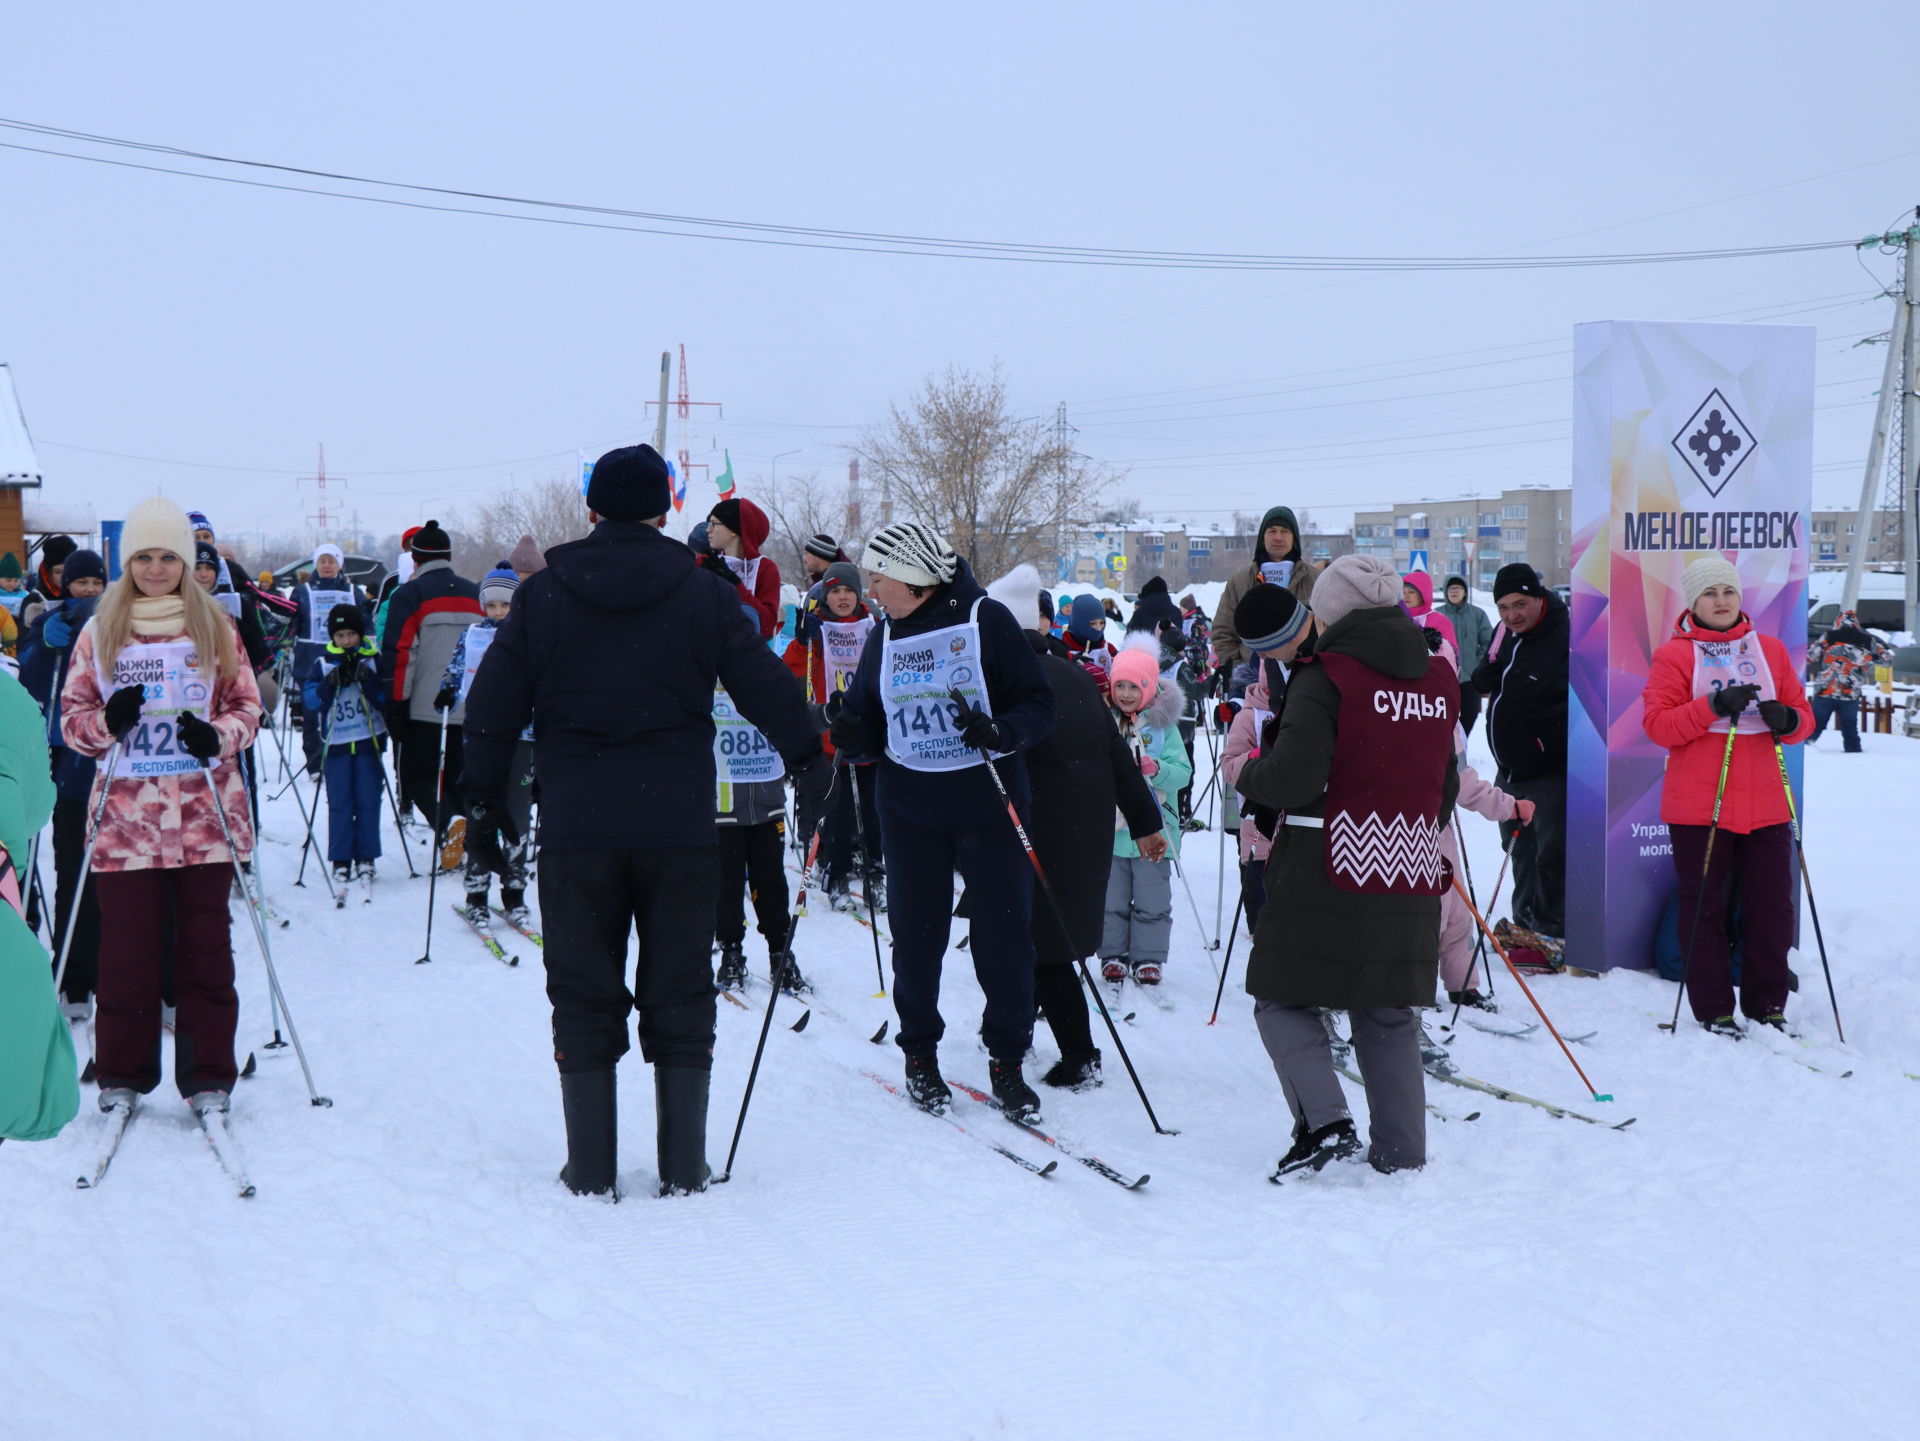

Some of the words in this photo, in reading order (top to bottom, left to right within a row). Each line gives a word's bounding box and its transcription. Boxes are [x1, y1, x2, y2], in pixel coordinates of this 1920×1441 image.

[1624, 511, 1799, 550] МЕНДЕЛЕЕВСК
[828, 630, 856, 638] ЛЫЖНЯ
[828, 638, 858, 647] РОССИИ
[892, 649, 934, 664] ЛЫЖНЯ
[892, 661, 935, 674] РОССИИ
[112, 671, 165, 685] РОССИИ
[891, 671, 934, 687] 2022
[1015, 823, 1033, 854] TREK
